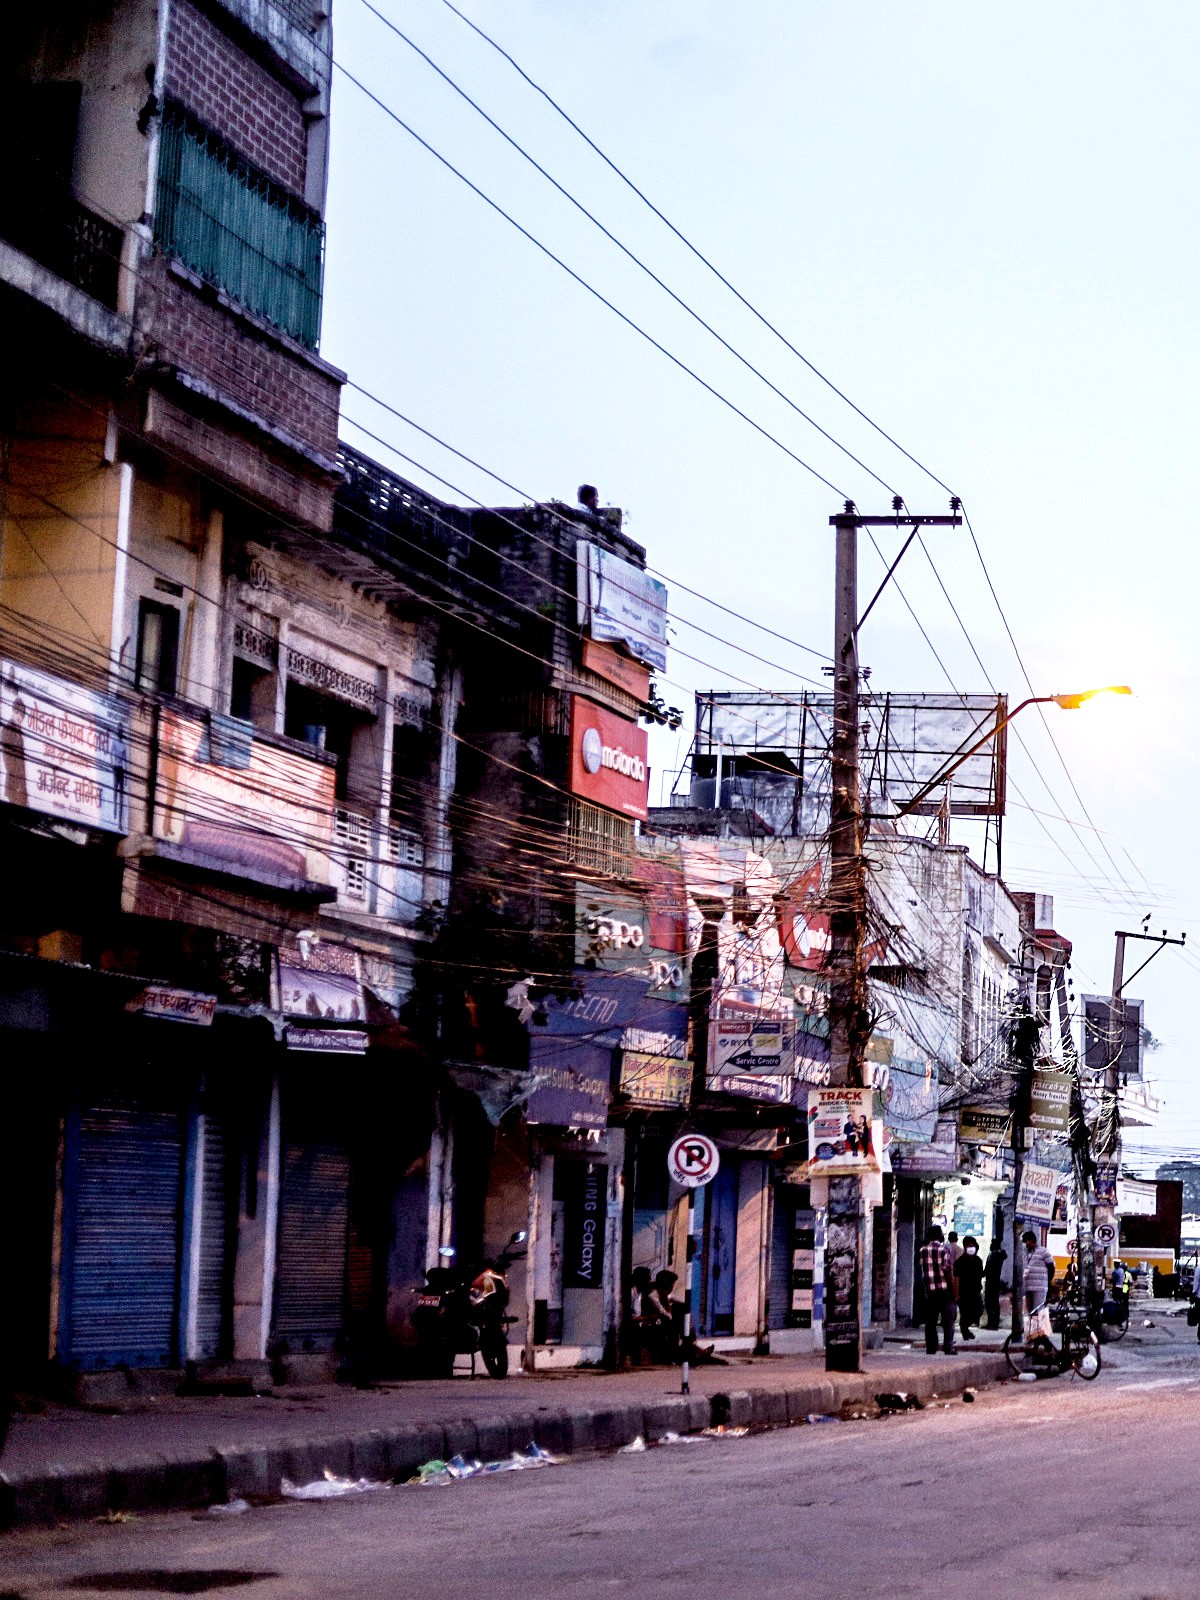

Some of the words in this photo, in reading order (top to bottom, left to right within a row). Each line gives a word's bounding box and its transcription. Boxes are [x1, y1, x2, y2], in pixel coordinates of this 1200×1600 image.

[819, 1091, 862, 1101] TRACK
[686, 1145, 705, 1167] P
[577, 1219, 597, 1279] Galaxy
